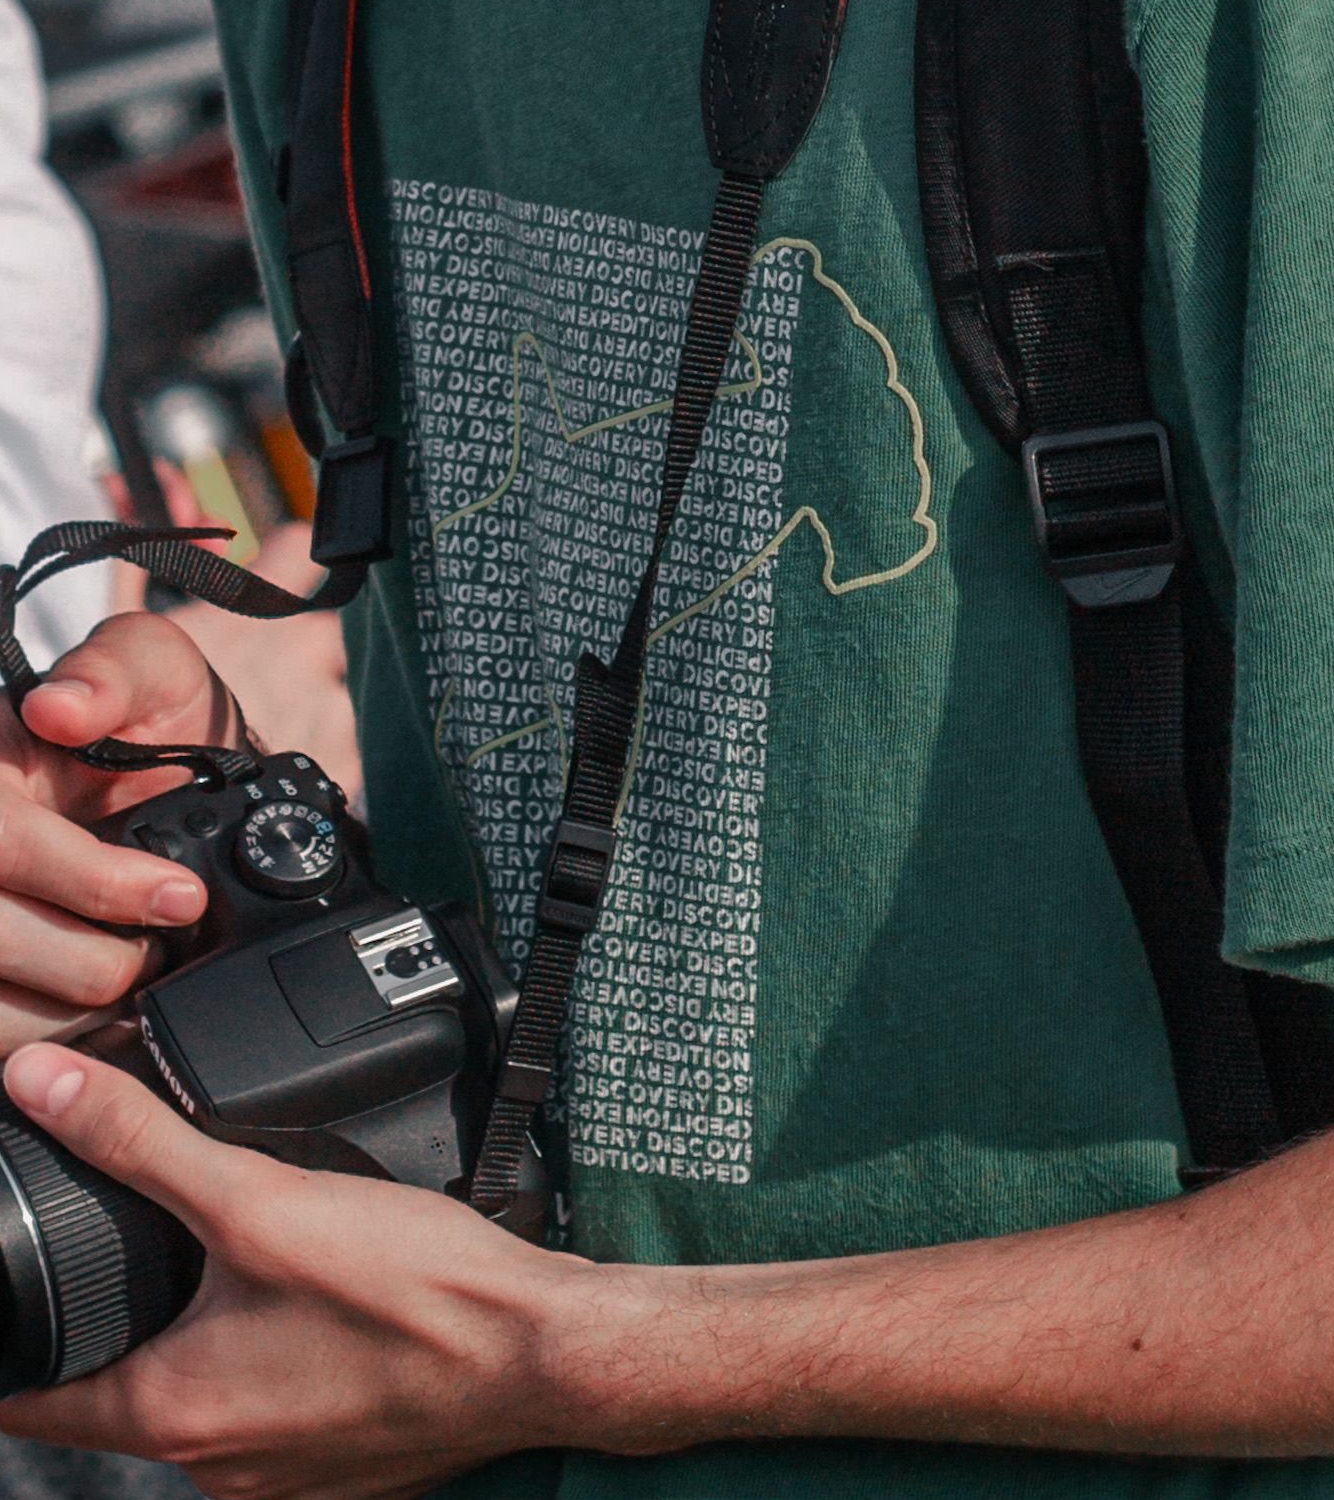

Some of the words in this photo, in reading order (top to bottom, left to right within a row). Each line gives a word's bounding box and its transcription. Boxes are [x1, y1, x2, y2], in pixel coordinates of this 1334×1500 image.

[392, 179, 493, 209] DISCOVERY
[543, 205, 637, 239] DISCOVERY
[557, 231, 654, 266] EXPEDITION
[553, 254, 651, 289] DISCOVERY
[578, 306, 679, 343] EXPEDITION
[591, 284, 690, 320] DISCOVERY
[735, 311, 797, 340] OVER
[717, 454, 784, 484] EXPED
[574, 520, 654, 556] DISCOVER
[699, 690, 767, 721] EXPED
[245, 784, 262, 799] ON
[652, 775, 765, 816] DISCOVER
[638, 797, 759, 838] EXPEDITION
[597, 910, 677, 944] DITION
[681, 925, 757, 956] EXPED
[625, 1011, 755, 1049] DISCOVER
[140, 1014, 194, 1115] Canon
[608, 1032, 751, 1072] EXPEDITION
[670, 1158, 751, 1184] EXPED
